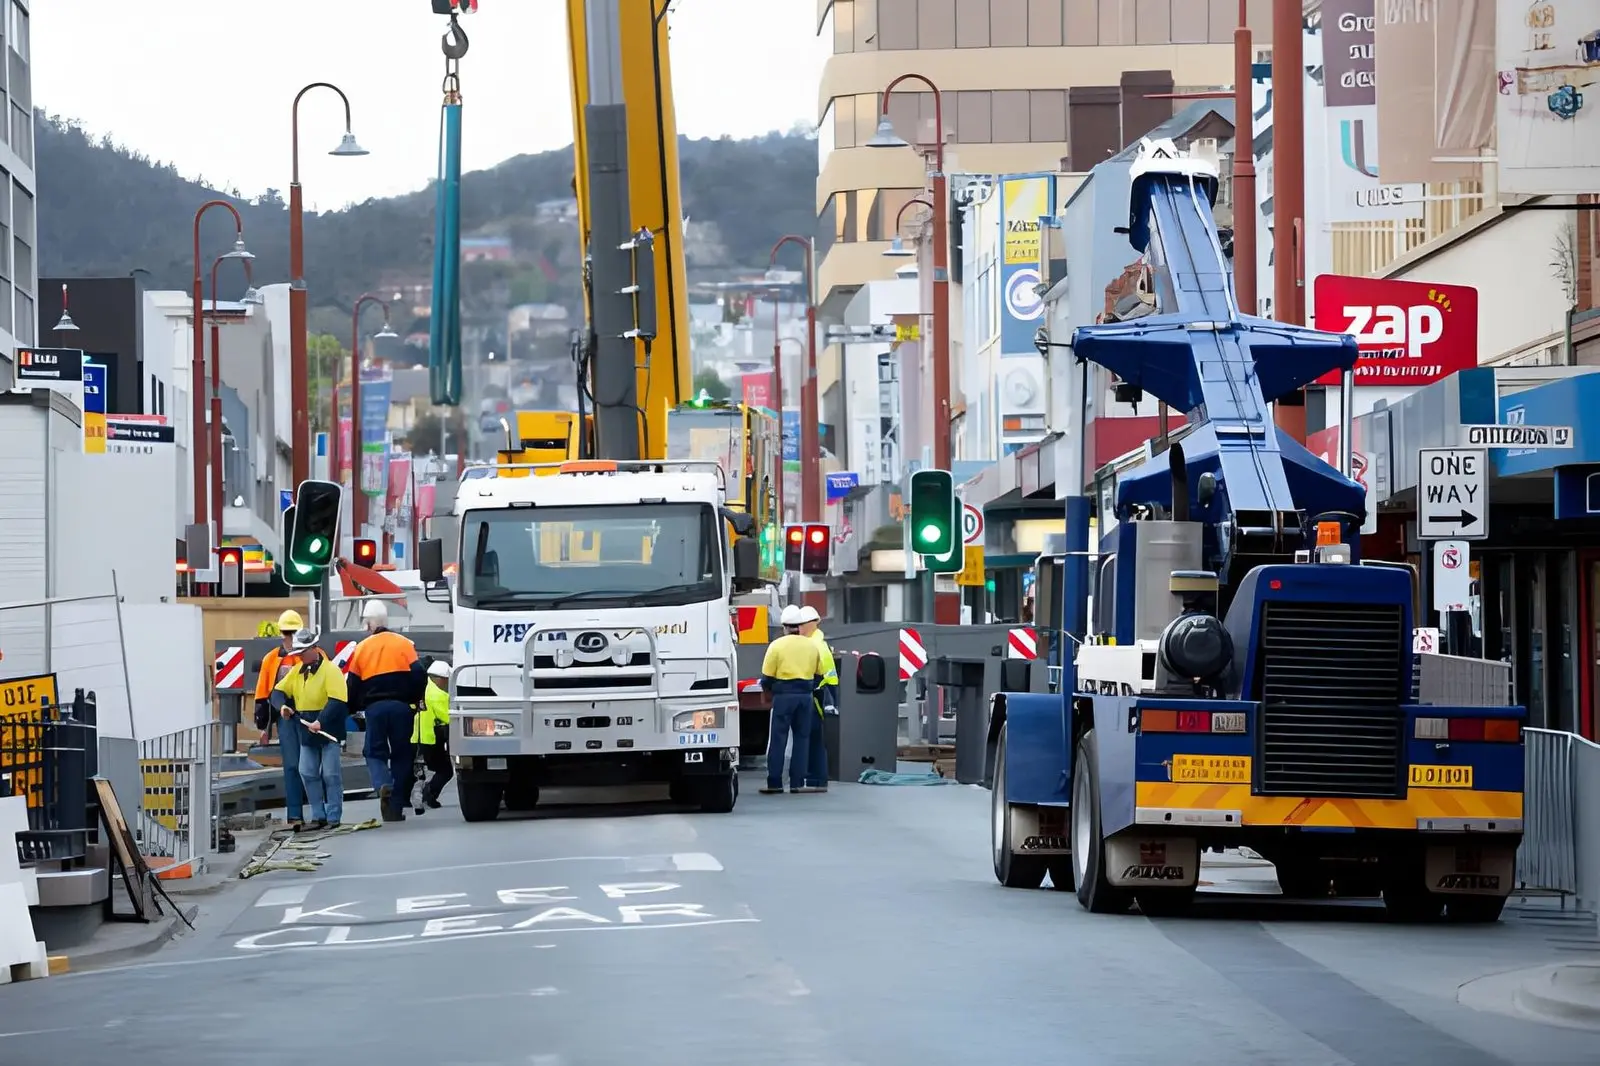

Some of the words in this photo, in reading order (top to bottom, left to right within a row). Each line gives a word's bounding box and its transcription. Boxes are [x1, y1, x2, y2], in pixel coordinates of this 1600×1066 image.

[1343, 304, 1444, 358] zap
[1430, 455, 1477, 476] ONE
[1427, 483, 1479, 504] WAY
[280, 880, 683, 924] KEEP
[233, 901, 717, 950] CLEAR
